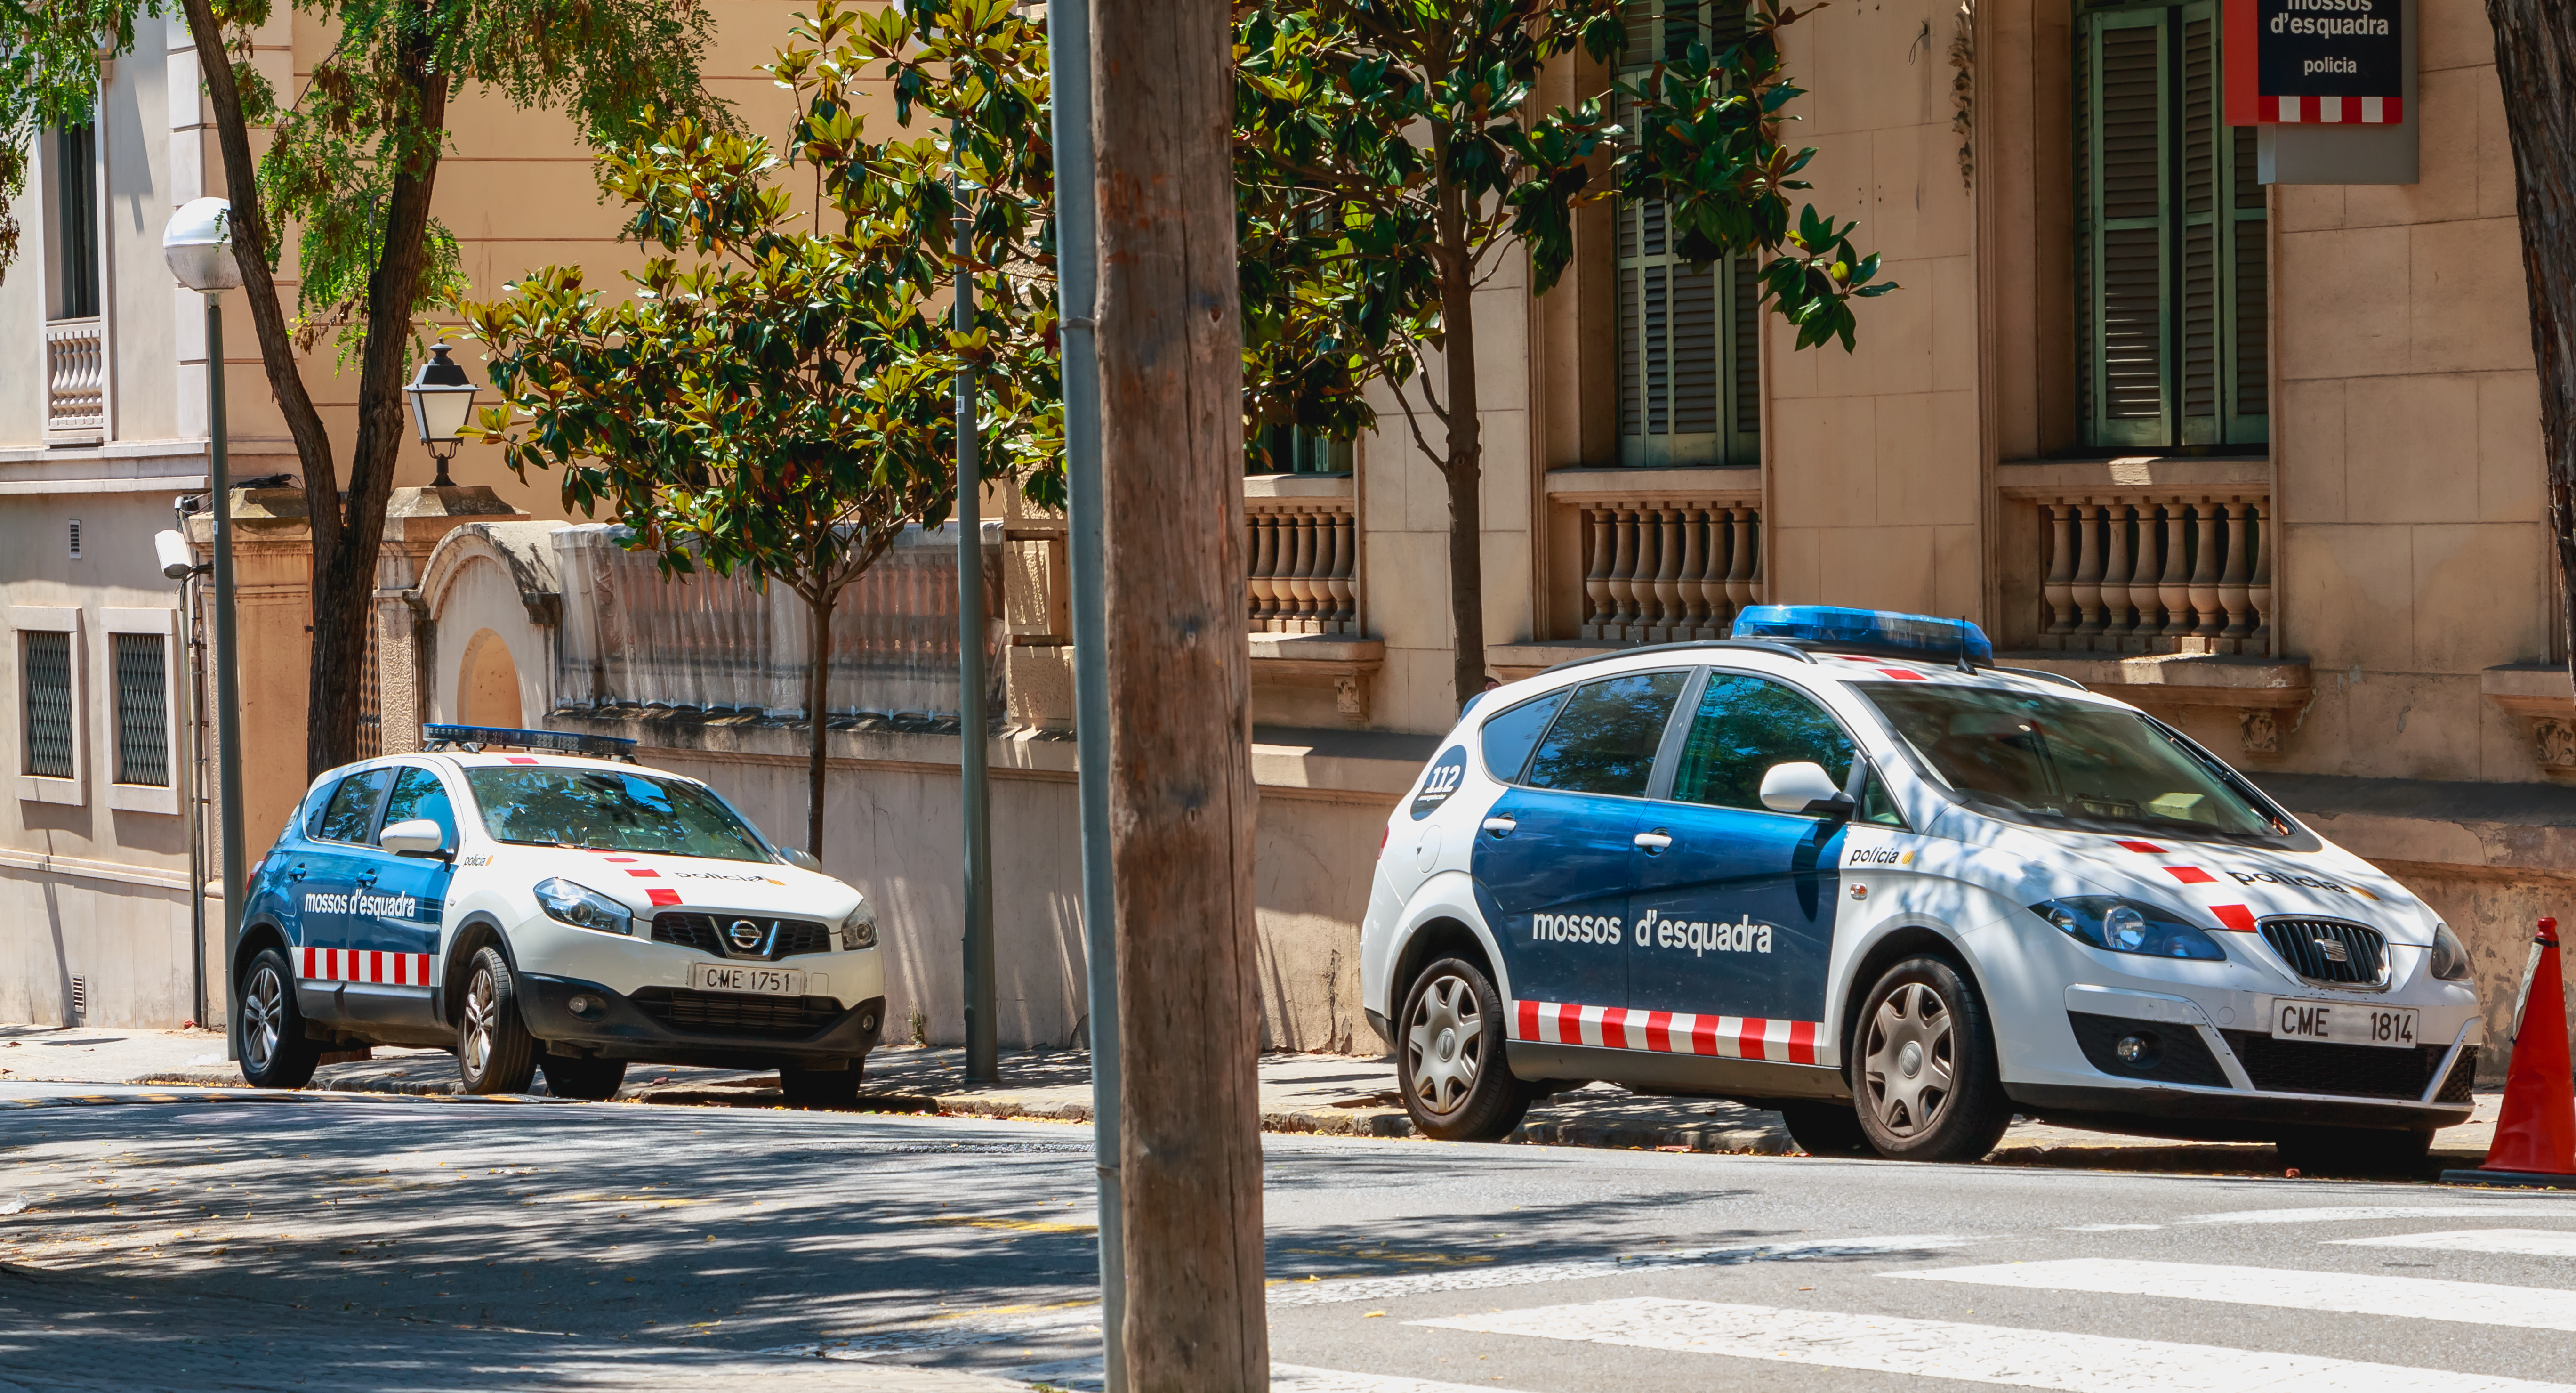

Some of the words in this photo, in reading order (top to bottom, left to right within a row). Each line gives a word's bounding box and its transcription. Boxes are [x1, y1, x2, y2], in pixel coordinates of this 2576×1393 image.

[2288, 0, 2372, 11] mossos
[2270, 12, 2389, 39] d'esquadra
[2304, 57, 2357, 76] policia
[1425, 765, 1461, 793] 112
[462, 853, 486, 867] policia
[1849, 847, 1900, 866] policia
[673, 872, 764, 882] policia
[2224, 871, 2351, 894] policia
[305, 893, 348, 915] mossos
[349, 888, 416, 922] d'esquadra
[1533, 913, 1621, 945] mossos
[1635, 909, 1772, 957] d'esquadra
[707, 968, 743, 989] CME
[750, 971, 790, 992] 1751
[2281, 1006, 2330, 1037] CME
[2371, 1012, 2413, 1043] 1814
